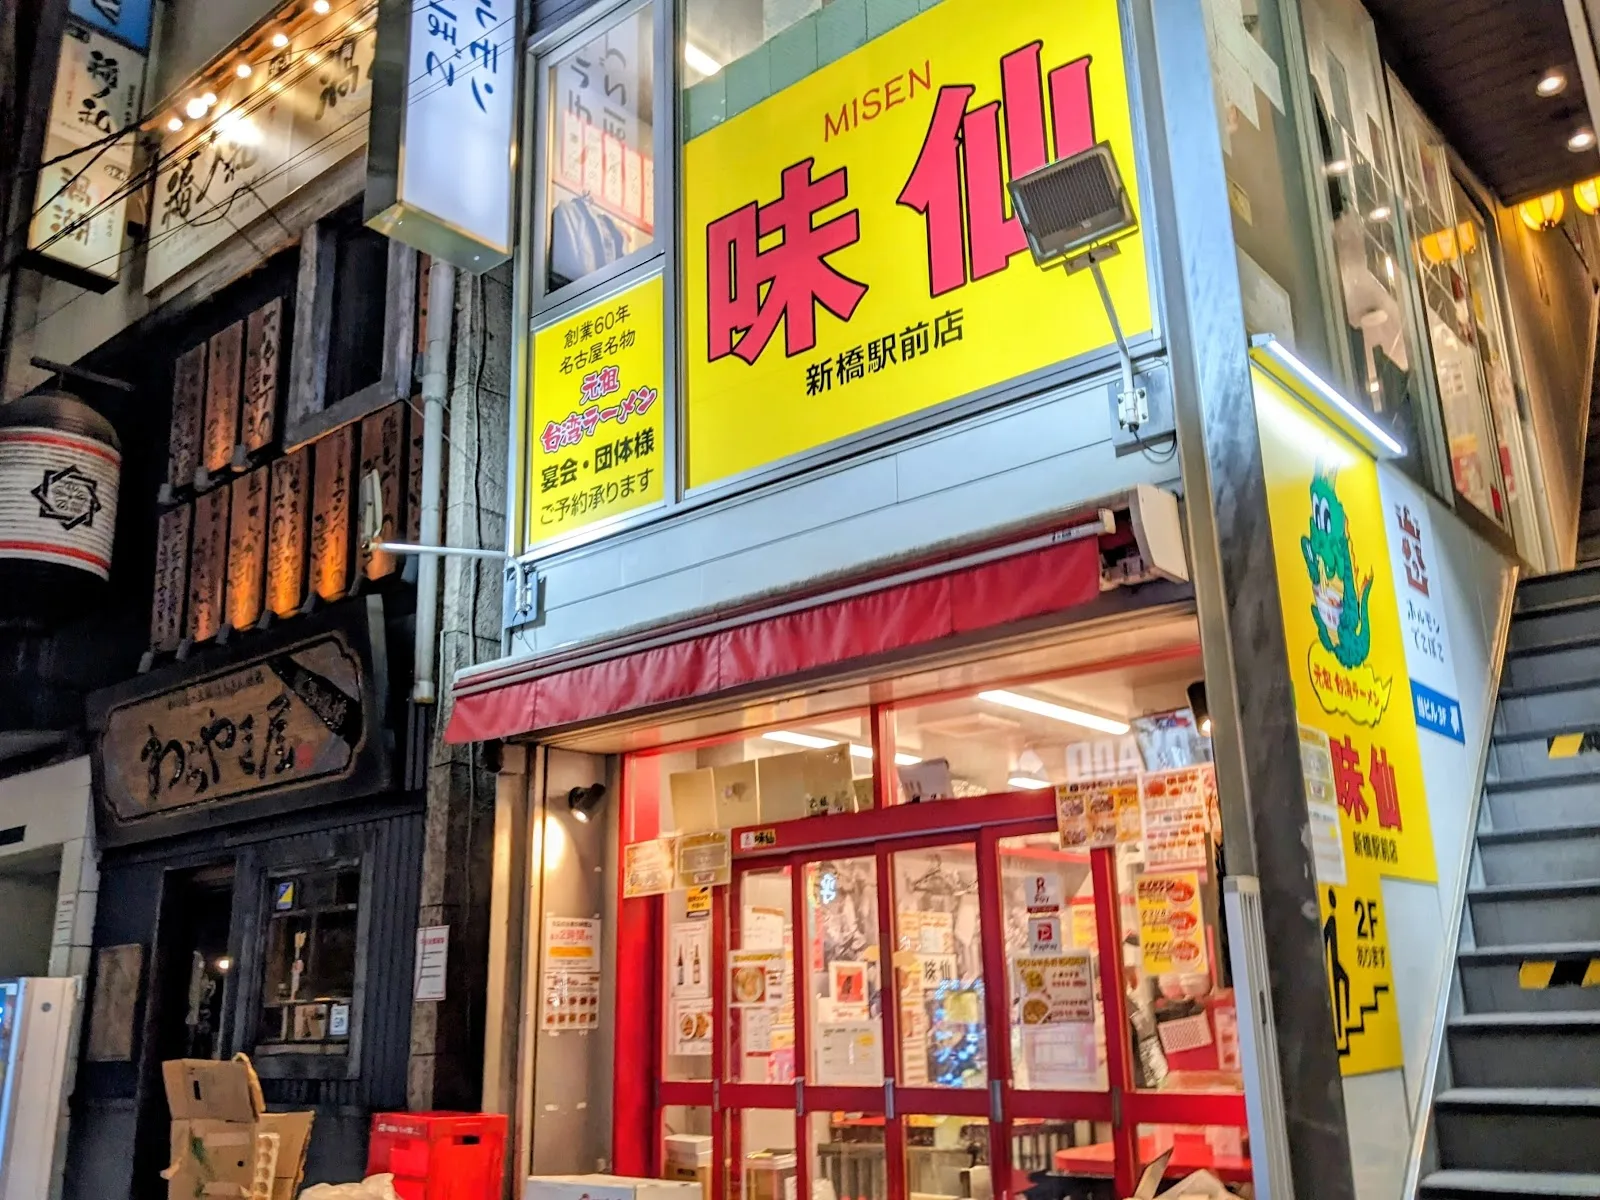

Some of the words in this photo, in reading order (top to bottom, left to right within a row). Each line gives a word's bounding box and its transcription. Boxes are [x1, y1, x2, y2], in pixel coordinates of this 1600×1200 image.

[823, 60, 932, 142] MISEN
[706, 39, 1093, 366] 味仙
[559, 329, 636, 375] 名古屋名物
[563, 304, 631, 350] 創業60年
[805, 308, 964, 397] 新橋駅前店
[579, 365, 620, 406] 元祖
[540, 385, 658, 454] 台湾ラーメン
[541, 427, 655, 493] 宴会・団体様
[540, 467, 654, 526] ご予約承ります
[1329, 734, 1403, 832] 味仙
[1354, 897, 1378, 940] 2F
